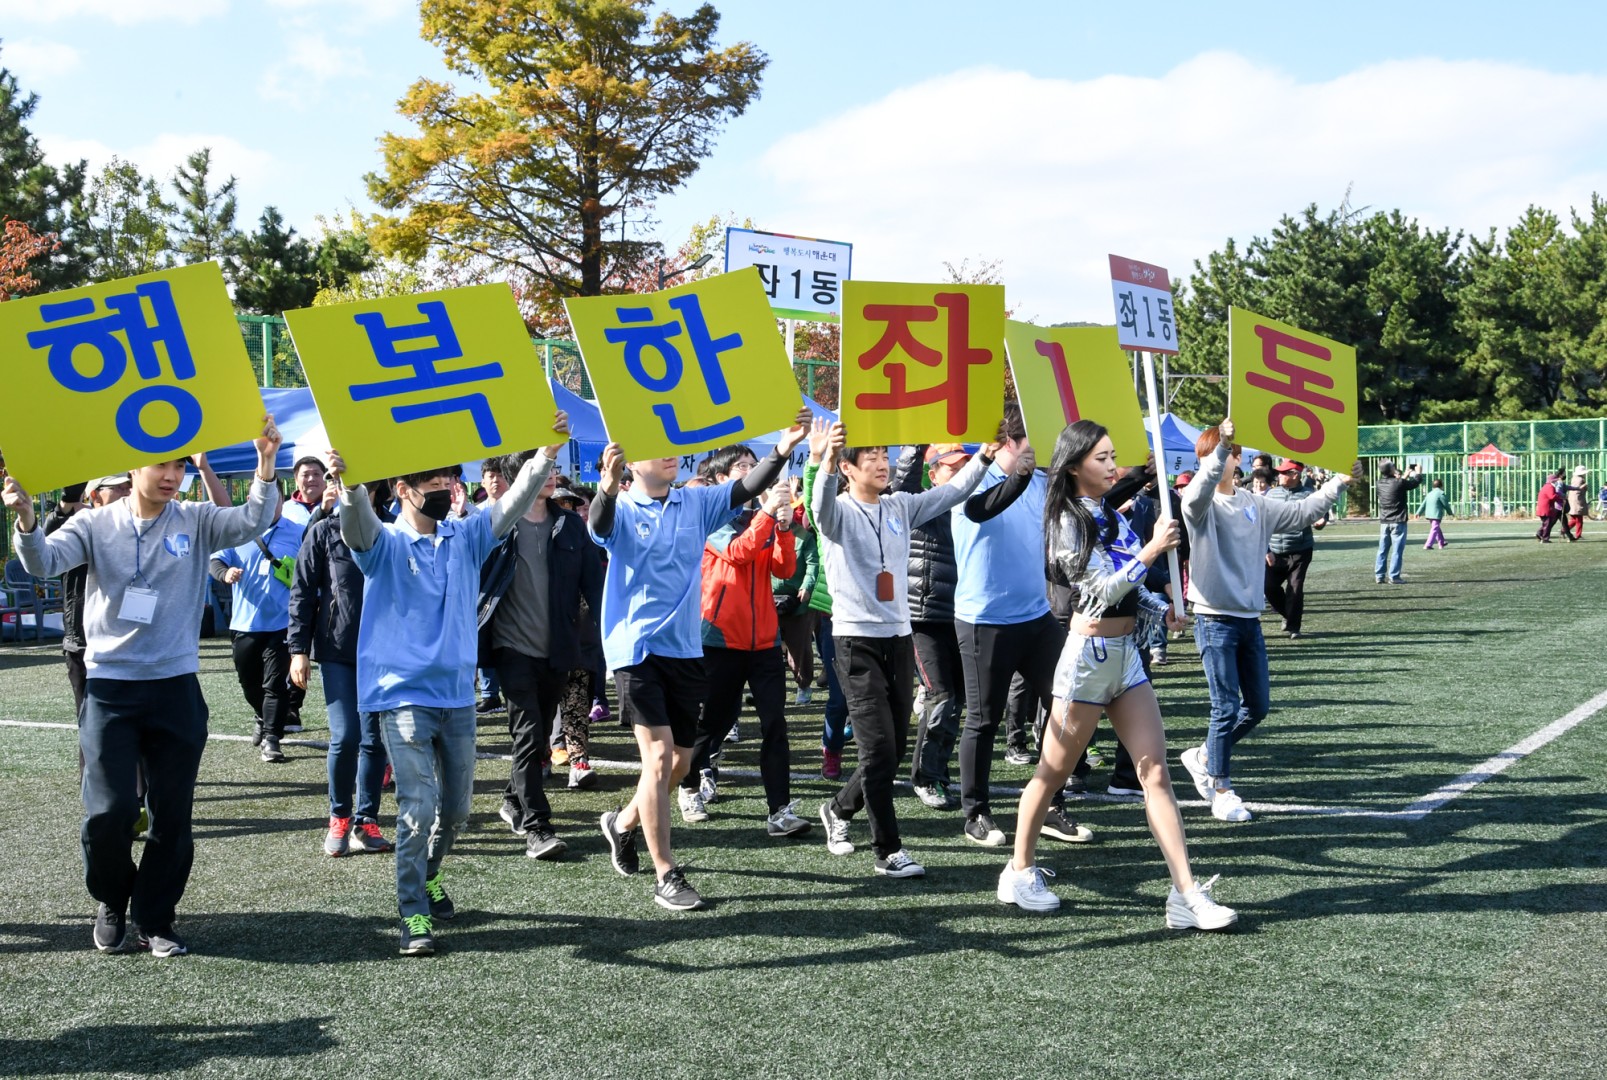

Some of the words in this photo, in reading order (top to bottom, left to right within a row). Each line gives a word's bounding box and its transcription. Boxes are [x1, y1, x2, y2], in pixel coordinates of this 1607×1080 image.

[27, 280, 203, 454] 행
[349, 300, 504, 448] 복
[604, 293, 745, 446] 한
[855, 292, 993, 437] 좌
[1245, 324, 1346, 454] 동
